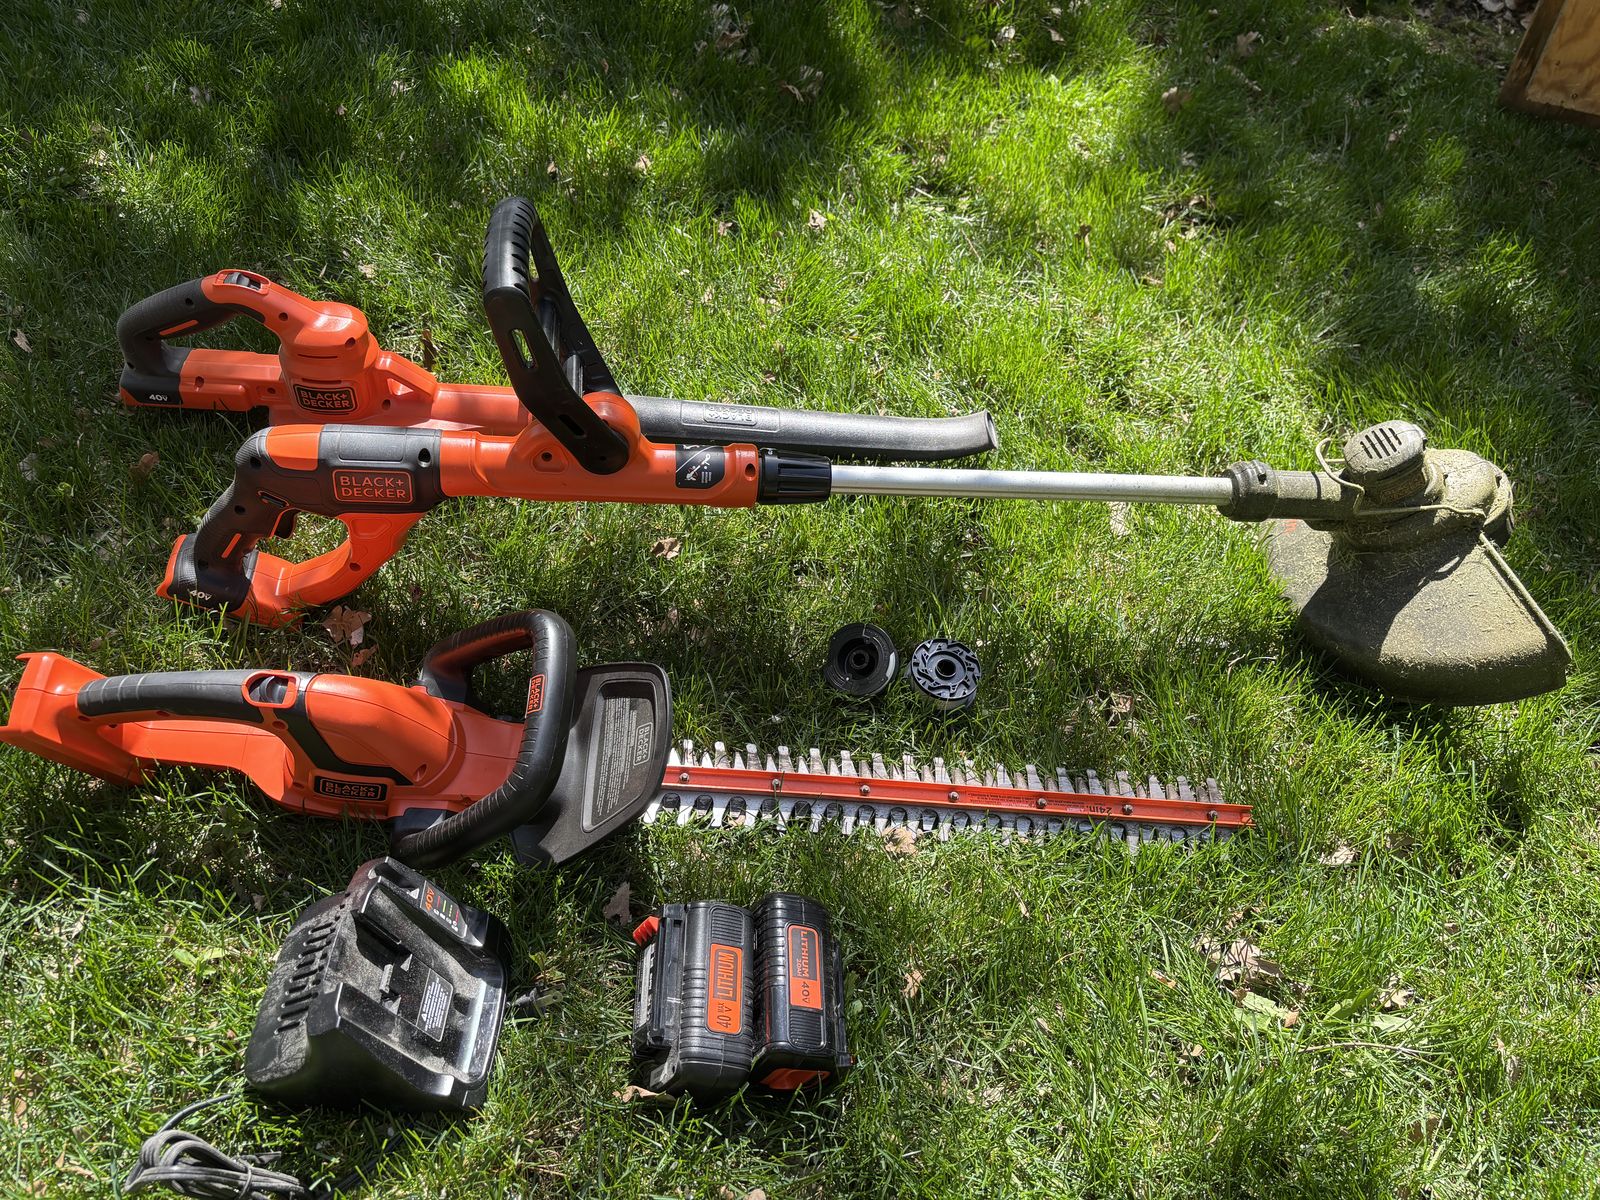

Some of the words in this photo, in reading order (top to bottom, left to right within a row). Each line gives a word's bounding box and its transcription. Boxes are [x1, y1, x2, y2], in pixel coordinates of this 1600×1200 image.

[301, 389, 348, 401] BLACK+
[303, 398, 350, 408] DECKER
[340, 476, 404, 488] BLACK+
[341, 487, 406, 498] DECKER
[533, 677, 542, 708] BLACK+
[642, 726, 650, 760] BLACK+
[325, 787, 376, 798] DECKER
[326, 782, 376, 792] BLACK+
[800, 930, 809, 978] LITHIUM
[716, 951, 735, 998] LITHIUM
[716, 1014, 732, 1029] 40
